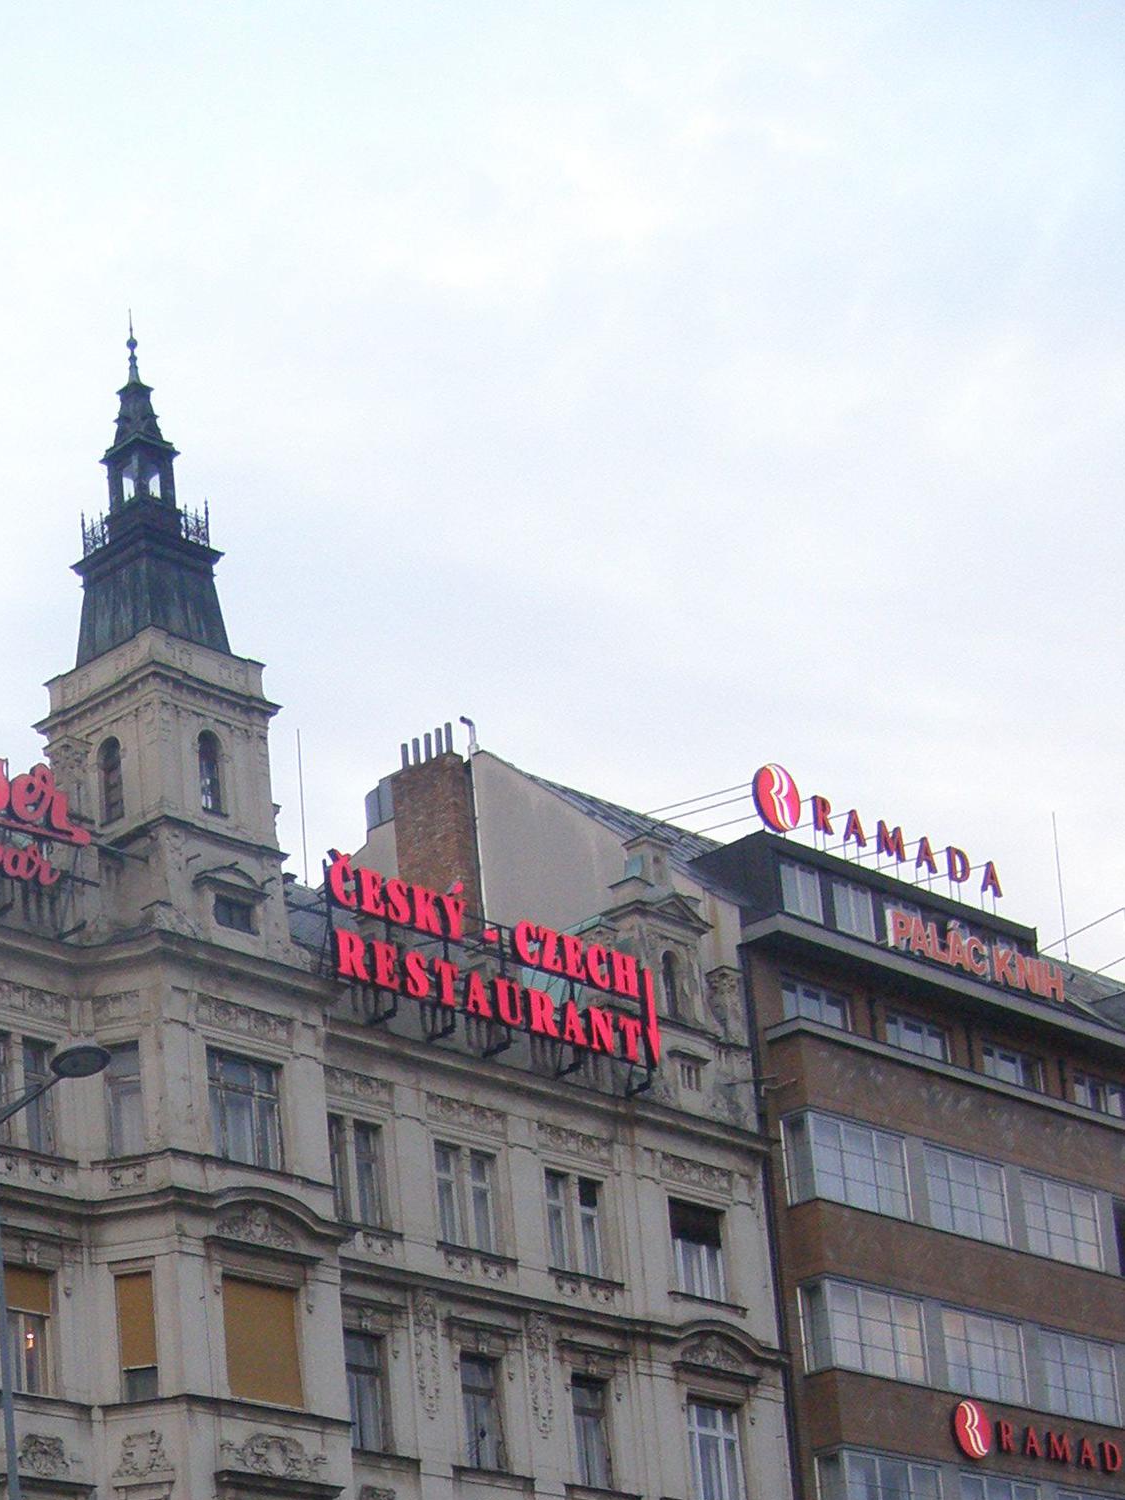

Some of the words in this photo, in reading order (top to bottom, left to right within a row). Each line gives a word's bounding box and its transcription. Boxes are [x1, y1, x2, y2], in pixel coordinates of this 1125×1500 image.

[811, 795, 1003, 898] RAMADA
[327, 848, 467, 942] ČESKÝ
[514, 919, 641, 999] CZECH
[888, 909, 988, 977] PALÁC
[991, 945, 1065, 1003] KNIH
[335, 928, 642, 1064] RESTAURANT
